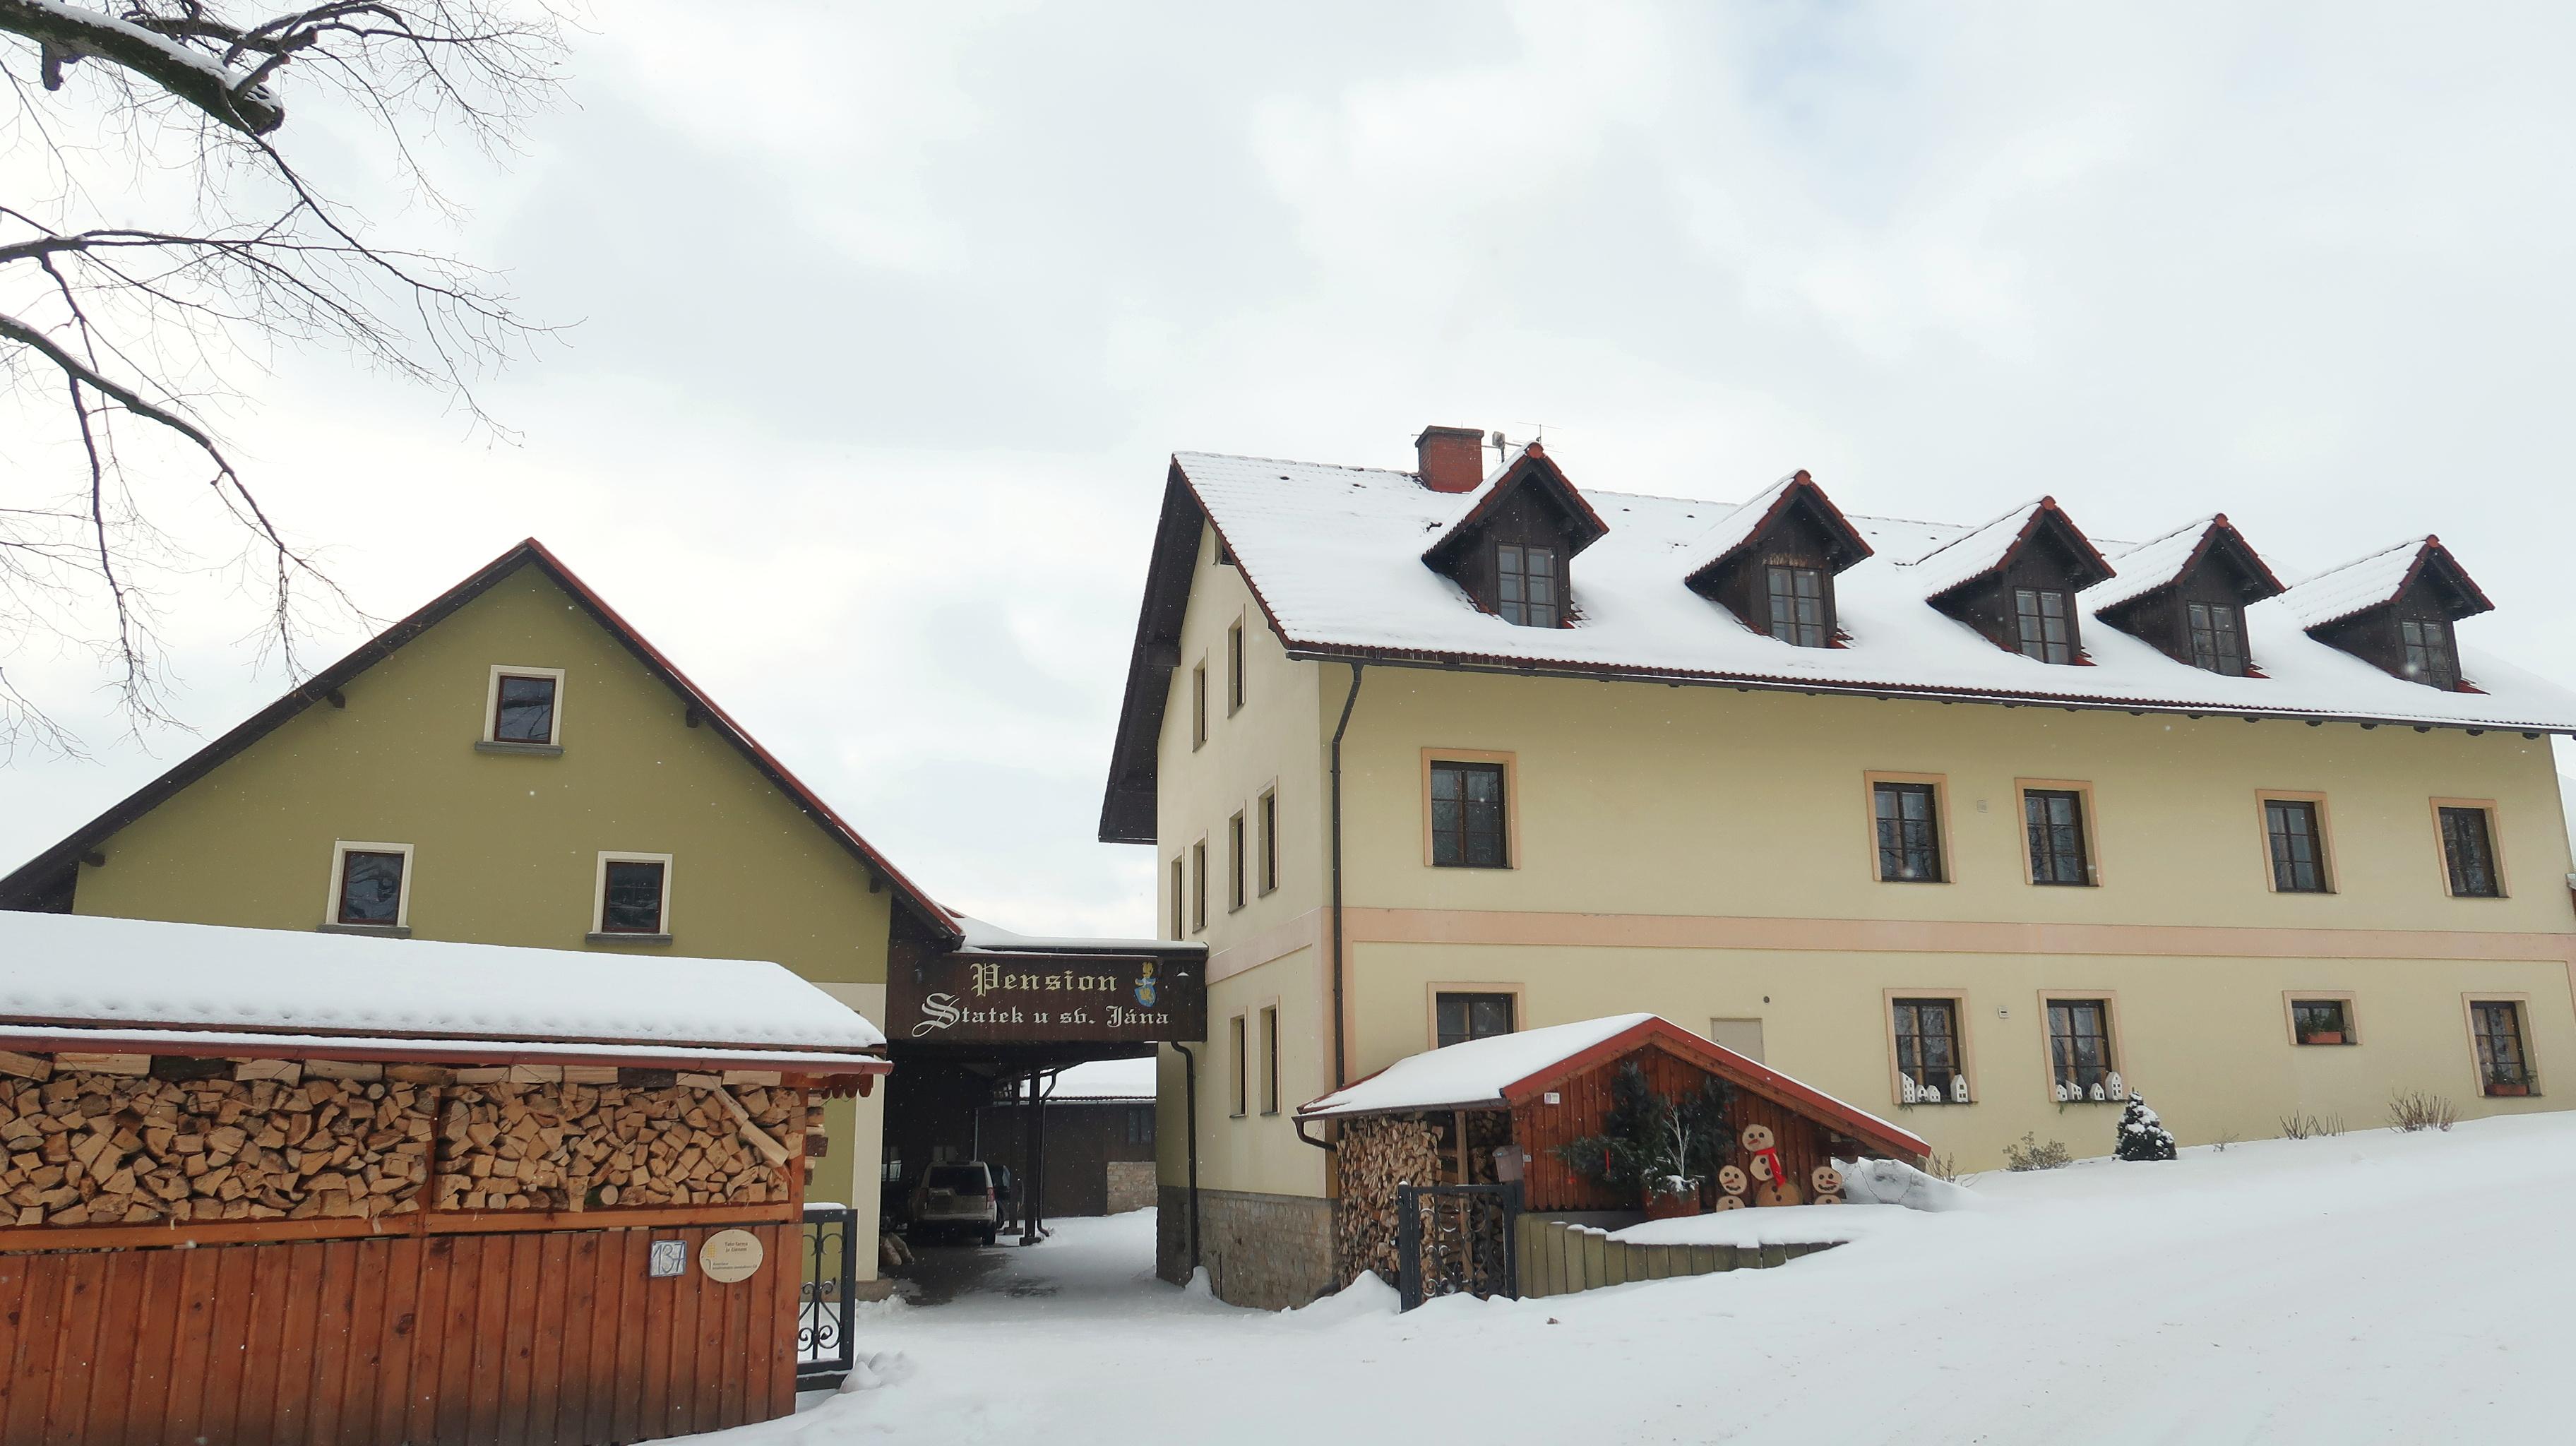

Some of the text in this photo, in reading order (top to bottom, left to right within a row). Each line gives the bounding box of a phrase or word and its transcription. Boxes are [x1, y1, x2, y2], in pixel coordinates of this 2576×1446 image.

[970, 963, 1118, 997] Pension
[912, 993, 1024, 1037] Statek
[1033, 1012, 1050, 1024] u
[1105, 1005, 1169, 1028] Jána
[652, 1243, 685, 1275] 137
